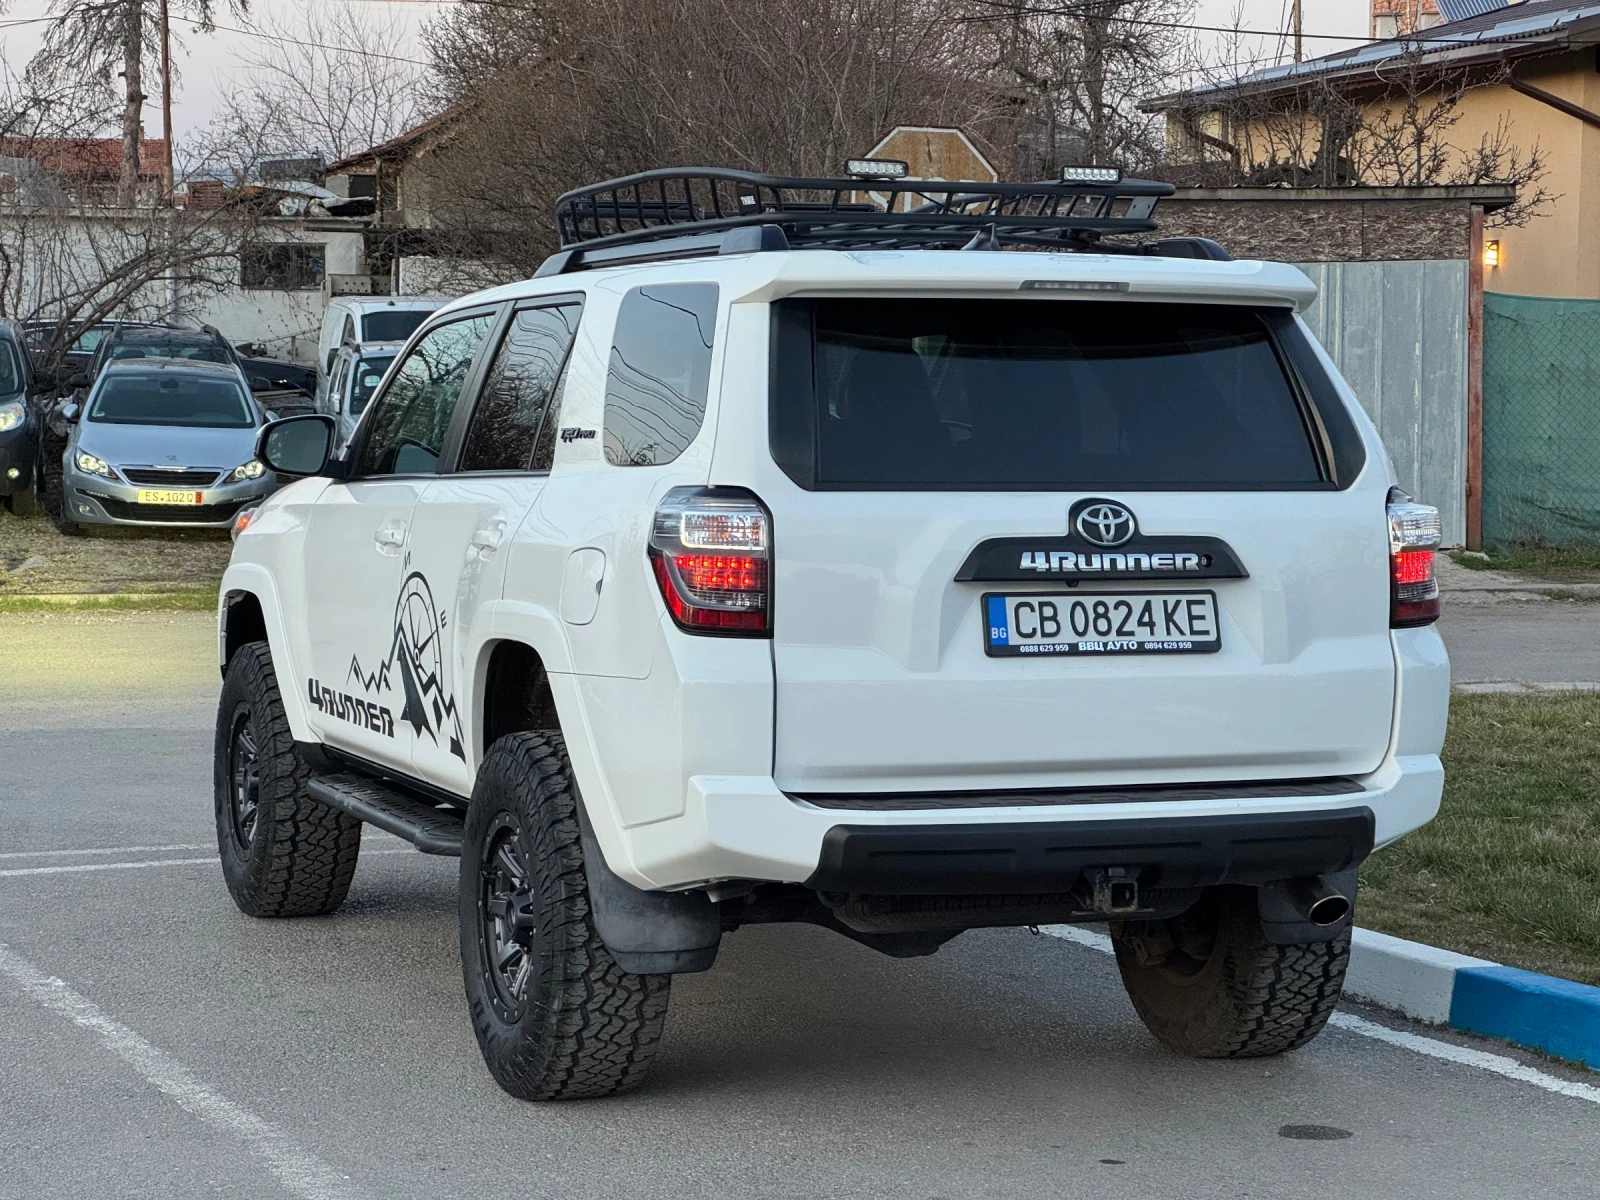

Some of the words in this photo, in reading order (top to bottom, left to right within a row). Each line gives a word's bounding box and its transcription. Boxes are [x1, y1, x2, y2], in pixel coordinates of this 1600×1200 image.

[1019, 551, 1199, 572] 4RUNNER
[1069, 599, 1156, 637] 0824
[991, 627, 1007, 638] BG
[1020, 645, 1039, 653] 0888
[1040, 644, 1054, 652] 629
[1054, 644, 1069, 652] 959
[1178, 641, 1192, 649] 959
[309, 677, 394, 739] 4RUNNER
